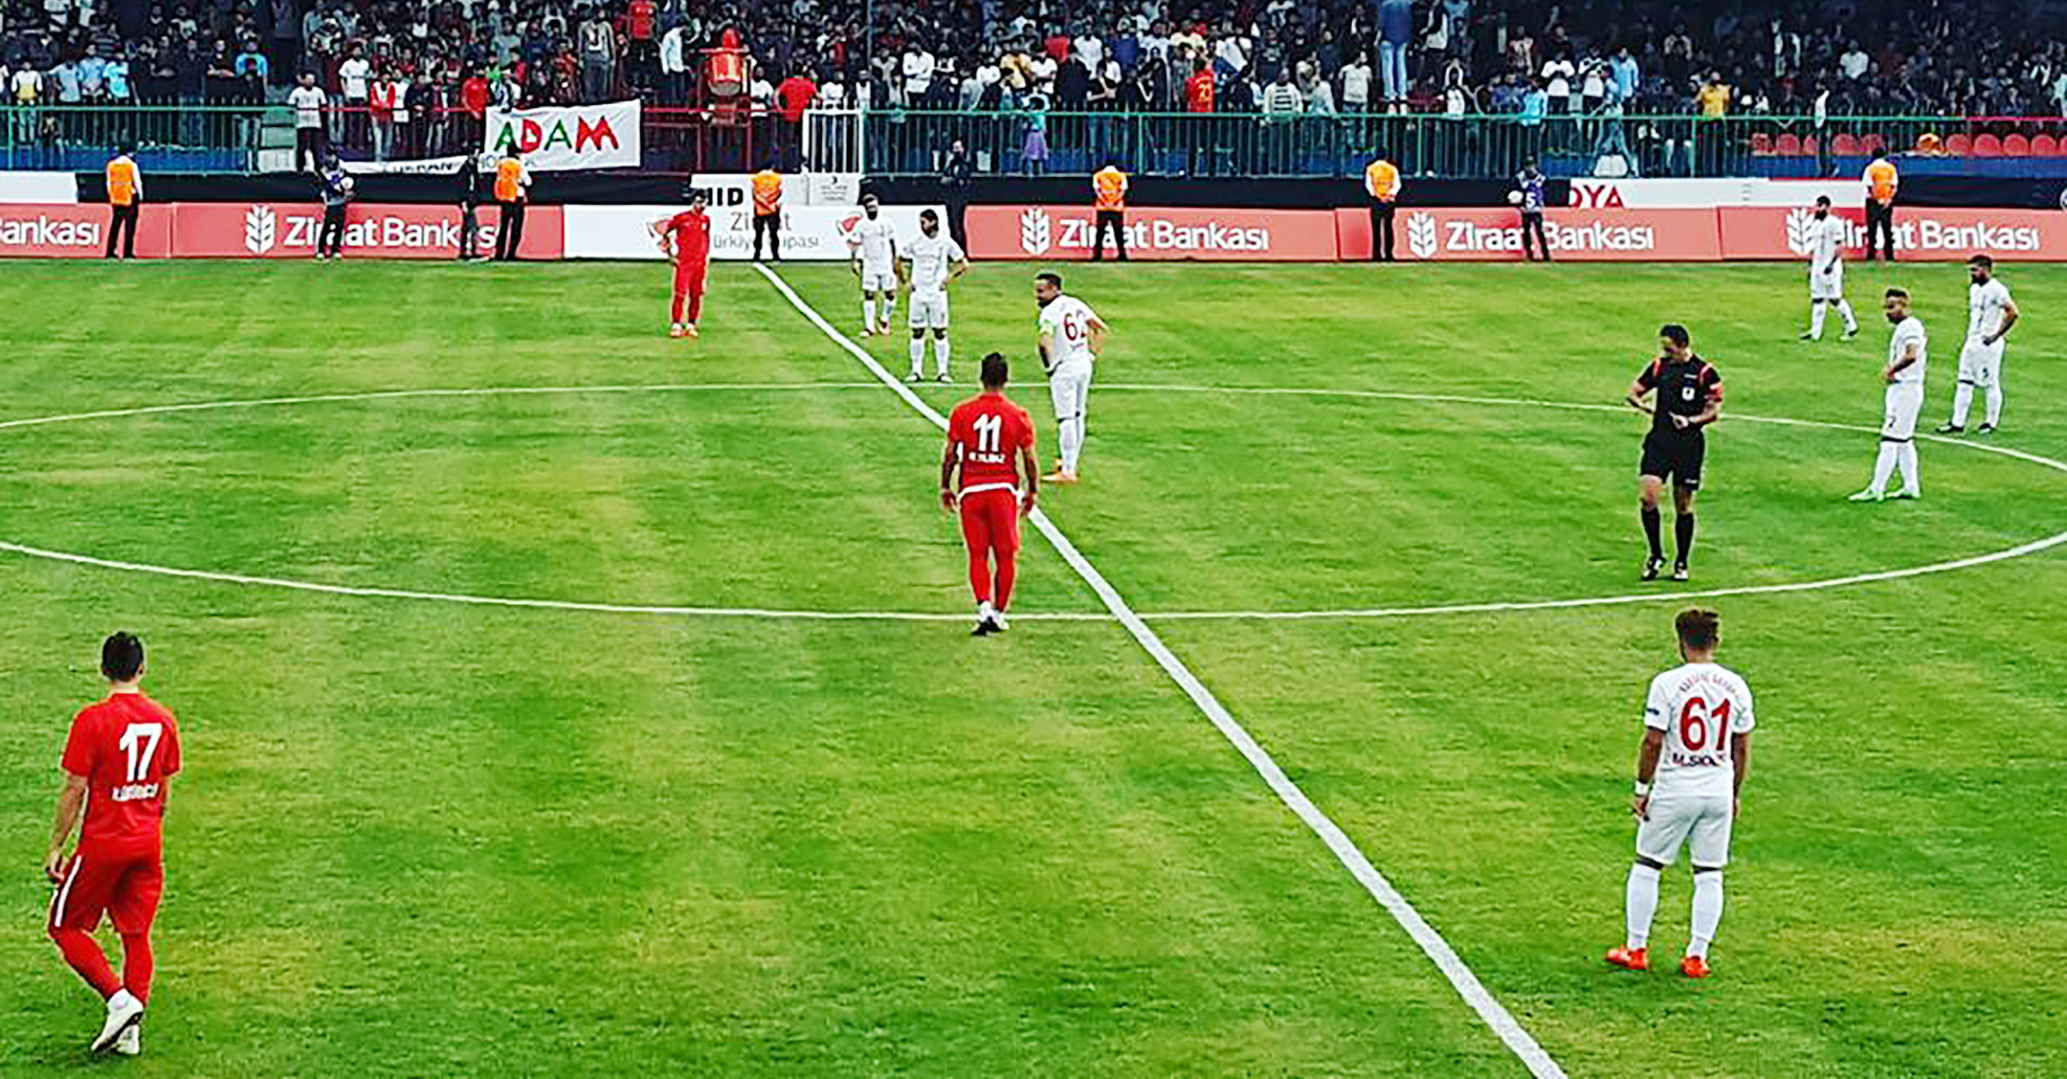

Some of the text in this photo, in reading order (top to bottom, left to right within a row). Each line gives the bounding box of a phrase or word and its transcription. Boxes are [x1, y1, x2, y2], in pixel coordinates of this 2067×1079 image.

[494, 115, 620, 153] ADAM
[0, 215, 100, 245] ankası
[383, 217, 500, 248] Banks
[1153, 220, 1268, 250] Bankası
[1545, 221, 1654, 250] Bankası
[1920, 220, 2040, 250] Bankası
[973, 413, 1002, 452] 11
[1680, 696, 1731, 751] 61
[119, 722, 163, 782] 17
